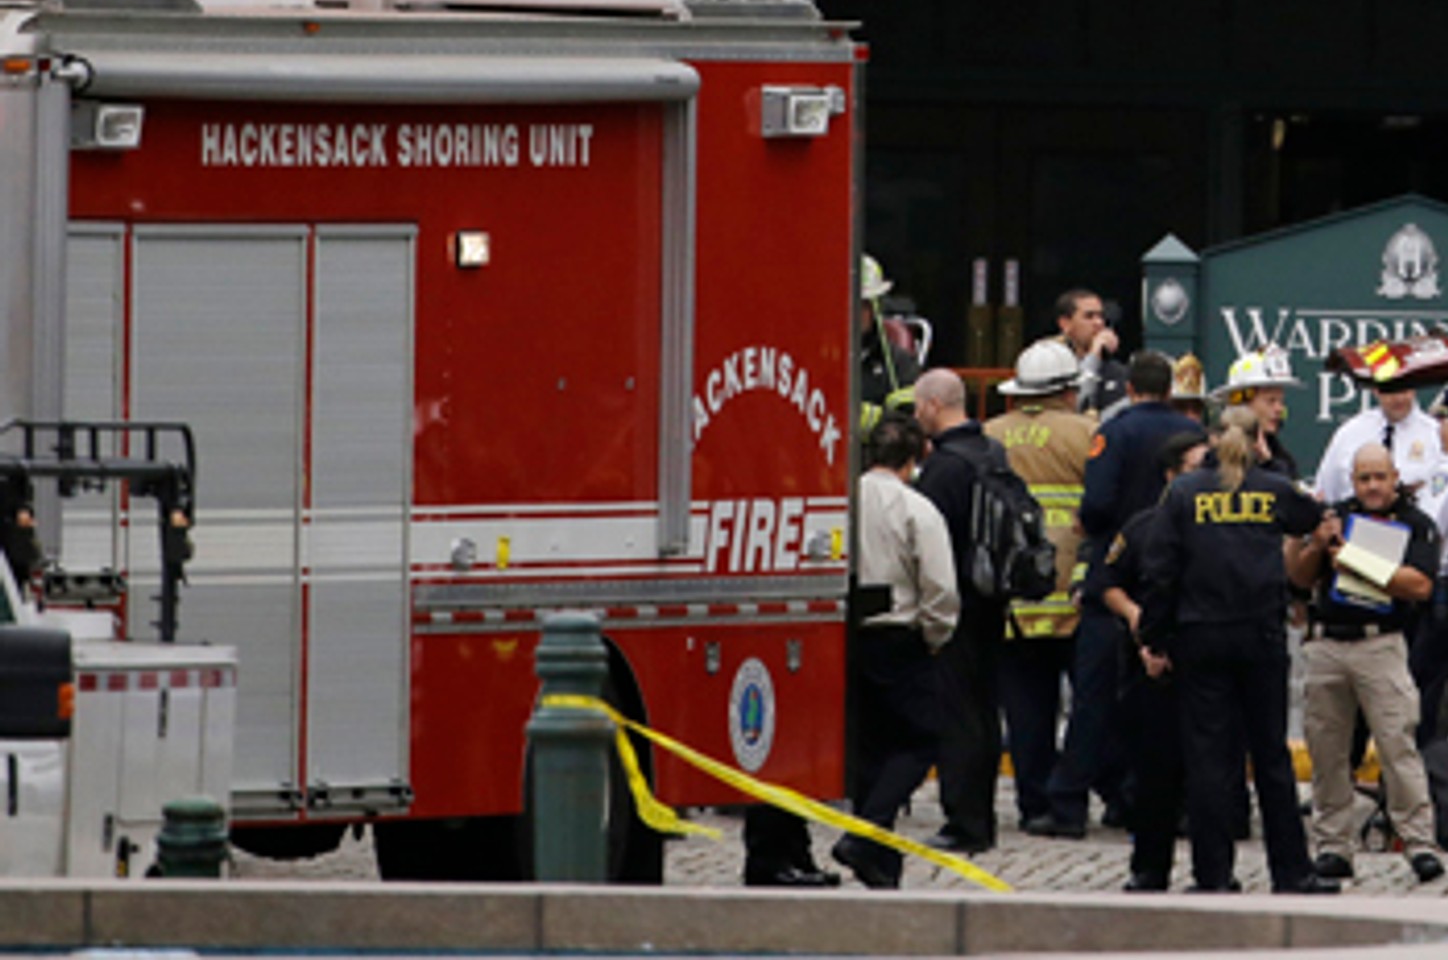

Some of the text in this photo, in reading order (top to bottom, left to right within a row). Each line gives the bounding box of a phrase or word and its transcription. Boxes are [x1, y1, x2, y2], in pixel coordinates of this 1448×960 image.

[201, 122, 594, 167] HACKENSACK SHORING UNIT
[690, 345, 842, 467] ACKENSACK
[706, 496, 804, 573] FIRE
[1194, 491, 1277, 524] POLICE
